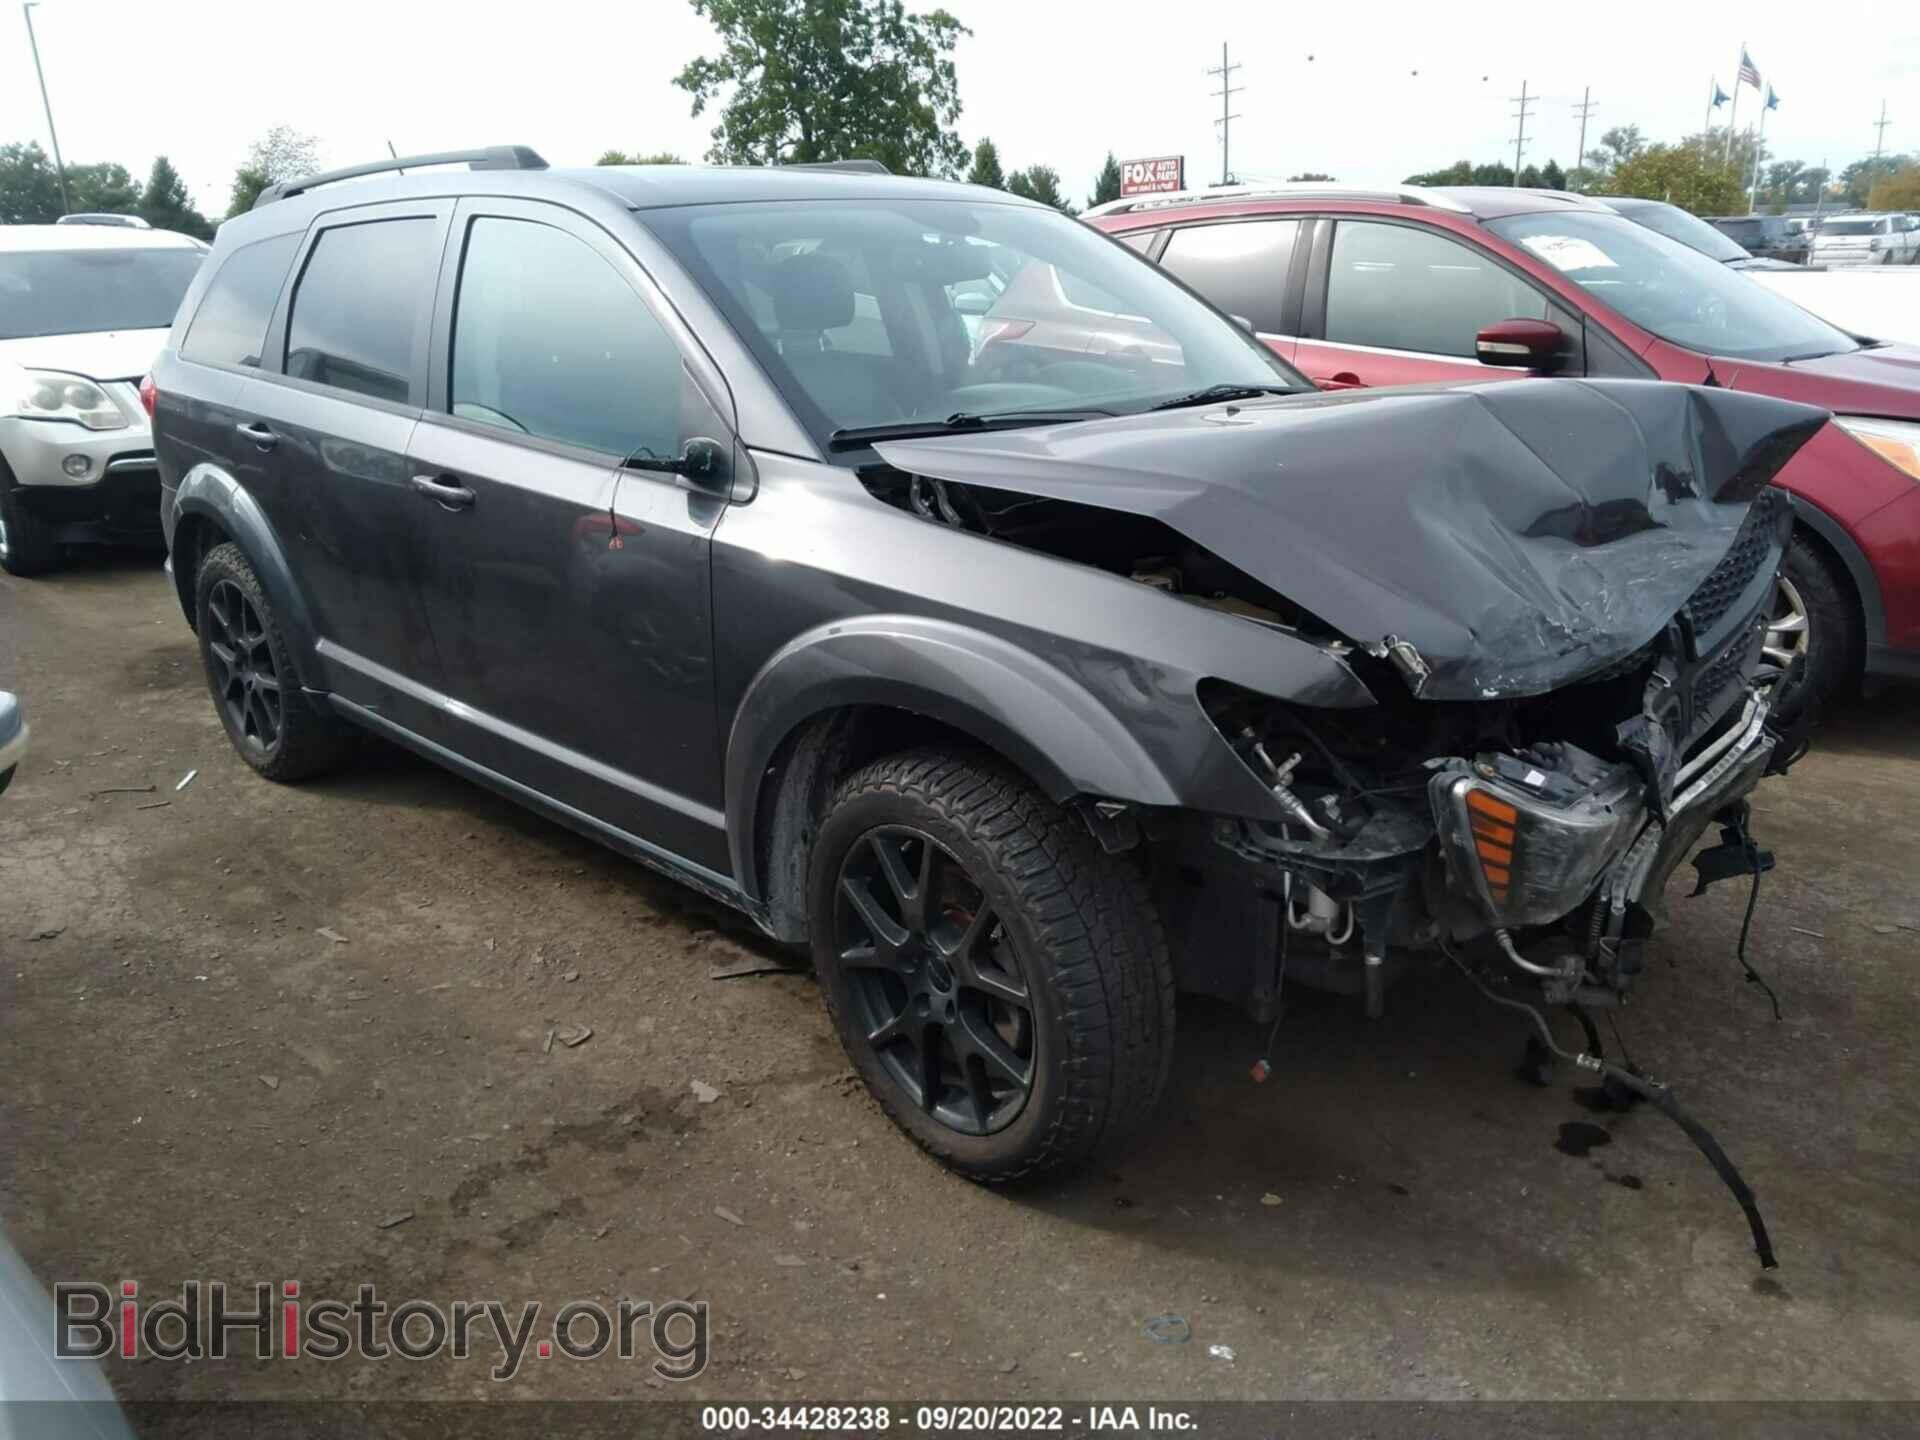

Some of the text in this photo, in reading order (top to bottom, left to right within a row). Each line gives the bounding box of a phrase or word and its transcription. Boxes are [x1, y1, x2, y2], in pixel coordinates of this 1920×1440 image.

[1157, 160, 1176, 171] AUTO
[1124, 161, 1156, 184] FOX
[1157, 170, 1177, 180] PARTS
